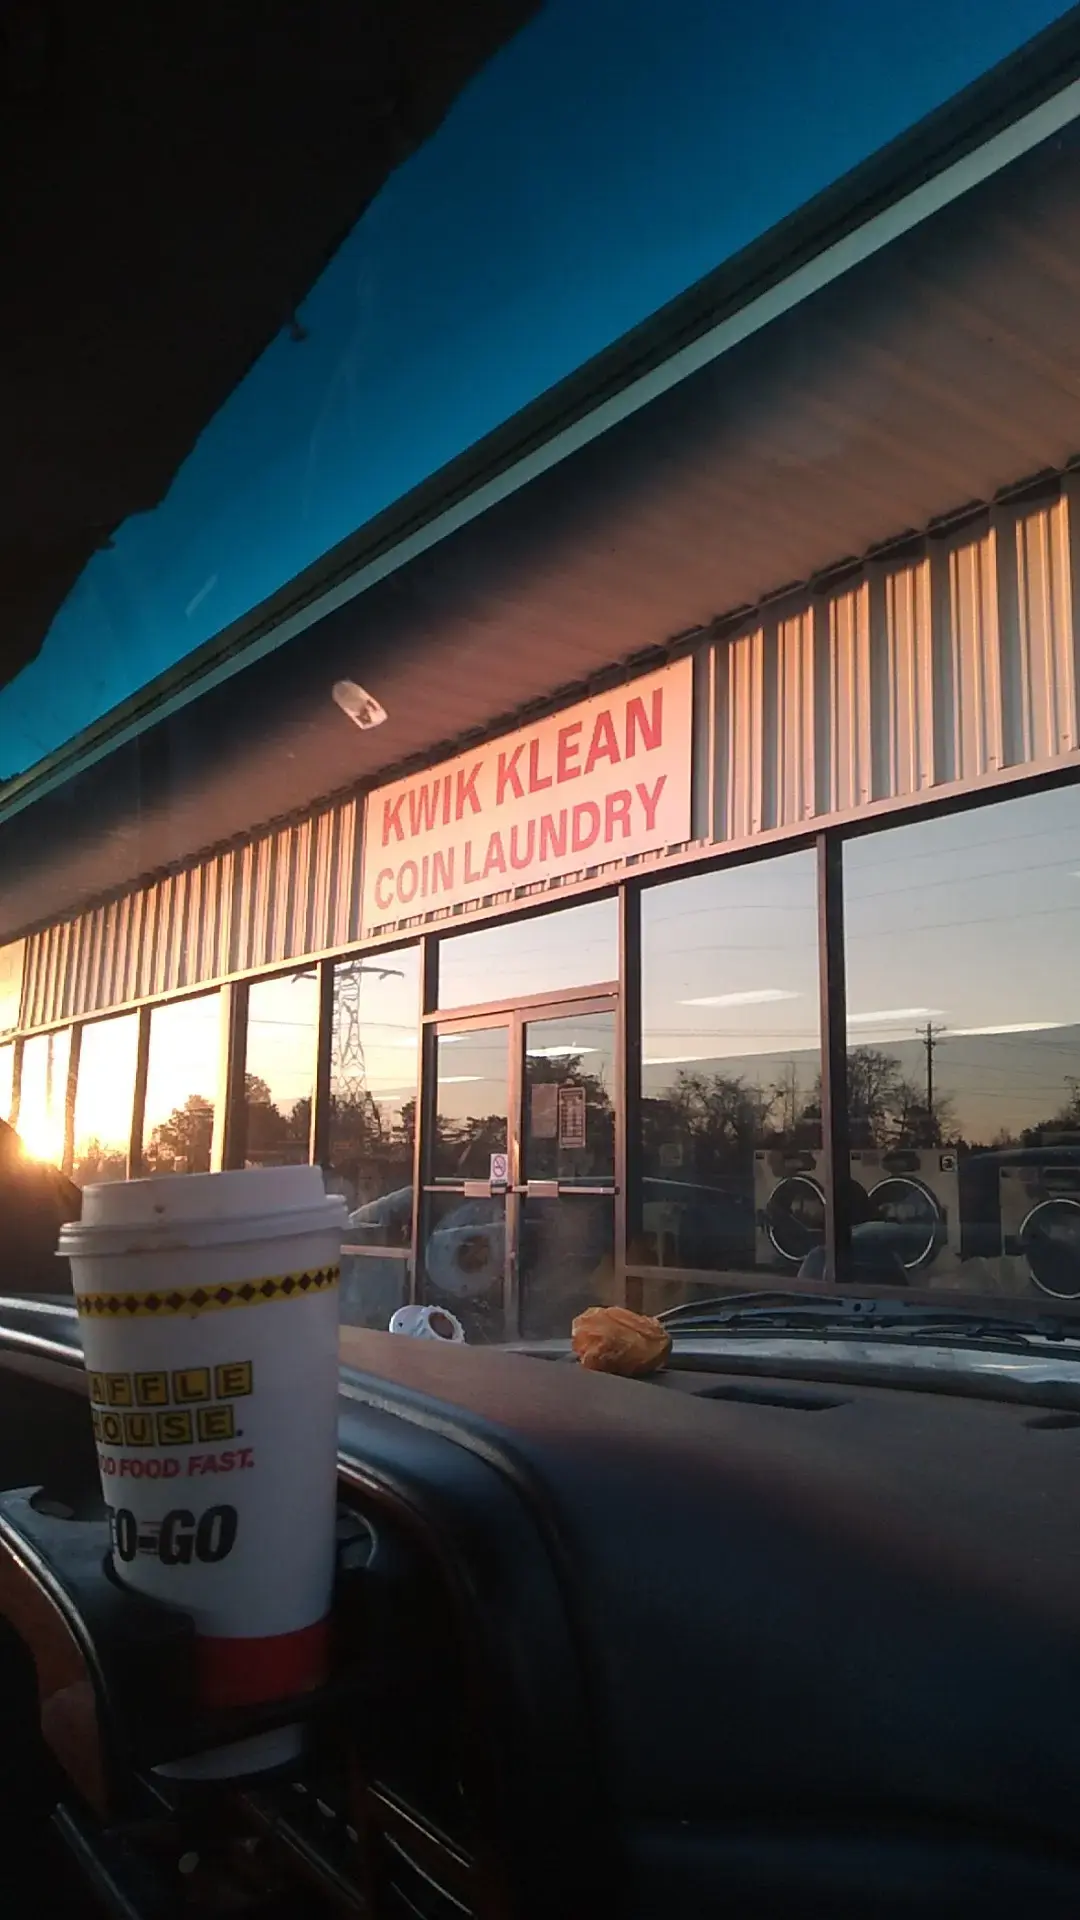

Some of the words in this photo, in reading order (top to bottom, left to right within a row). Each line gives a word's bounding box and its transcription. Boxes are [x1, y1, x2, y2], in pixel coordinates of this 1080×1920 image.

[381, 761, 484, 847] KWIK
[496, 687, 663, 806] KLEAN
[374, 847, 454, 910] COIN
[463, 775, 668, 883] LAUNDRY
[91, 1366, 246, 1402] AFFLE
[120, 1458, 181, 1479] FOOD
[113, 1504, 238, 1565] O-GO
